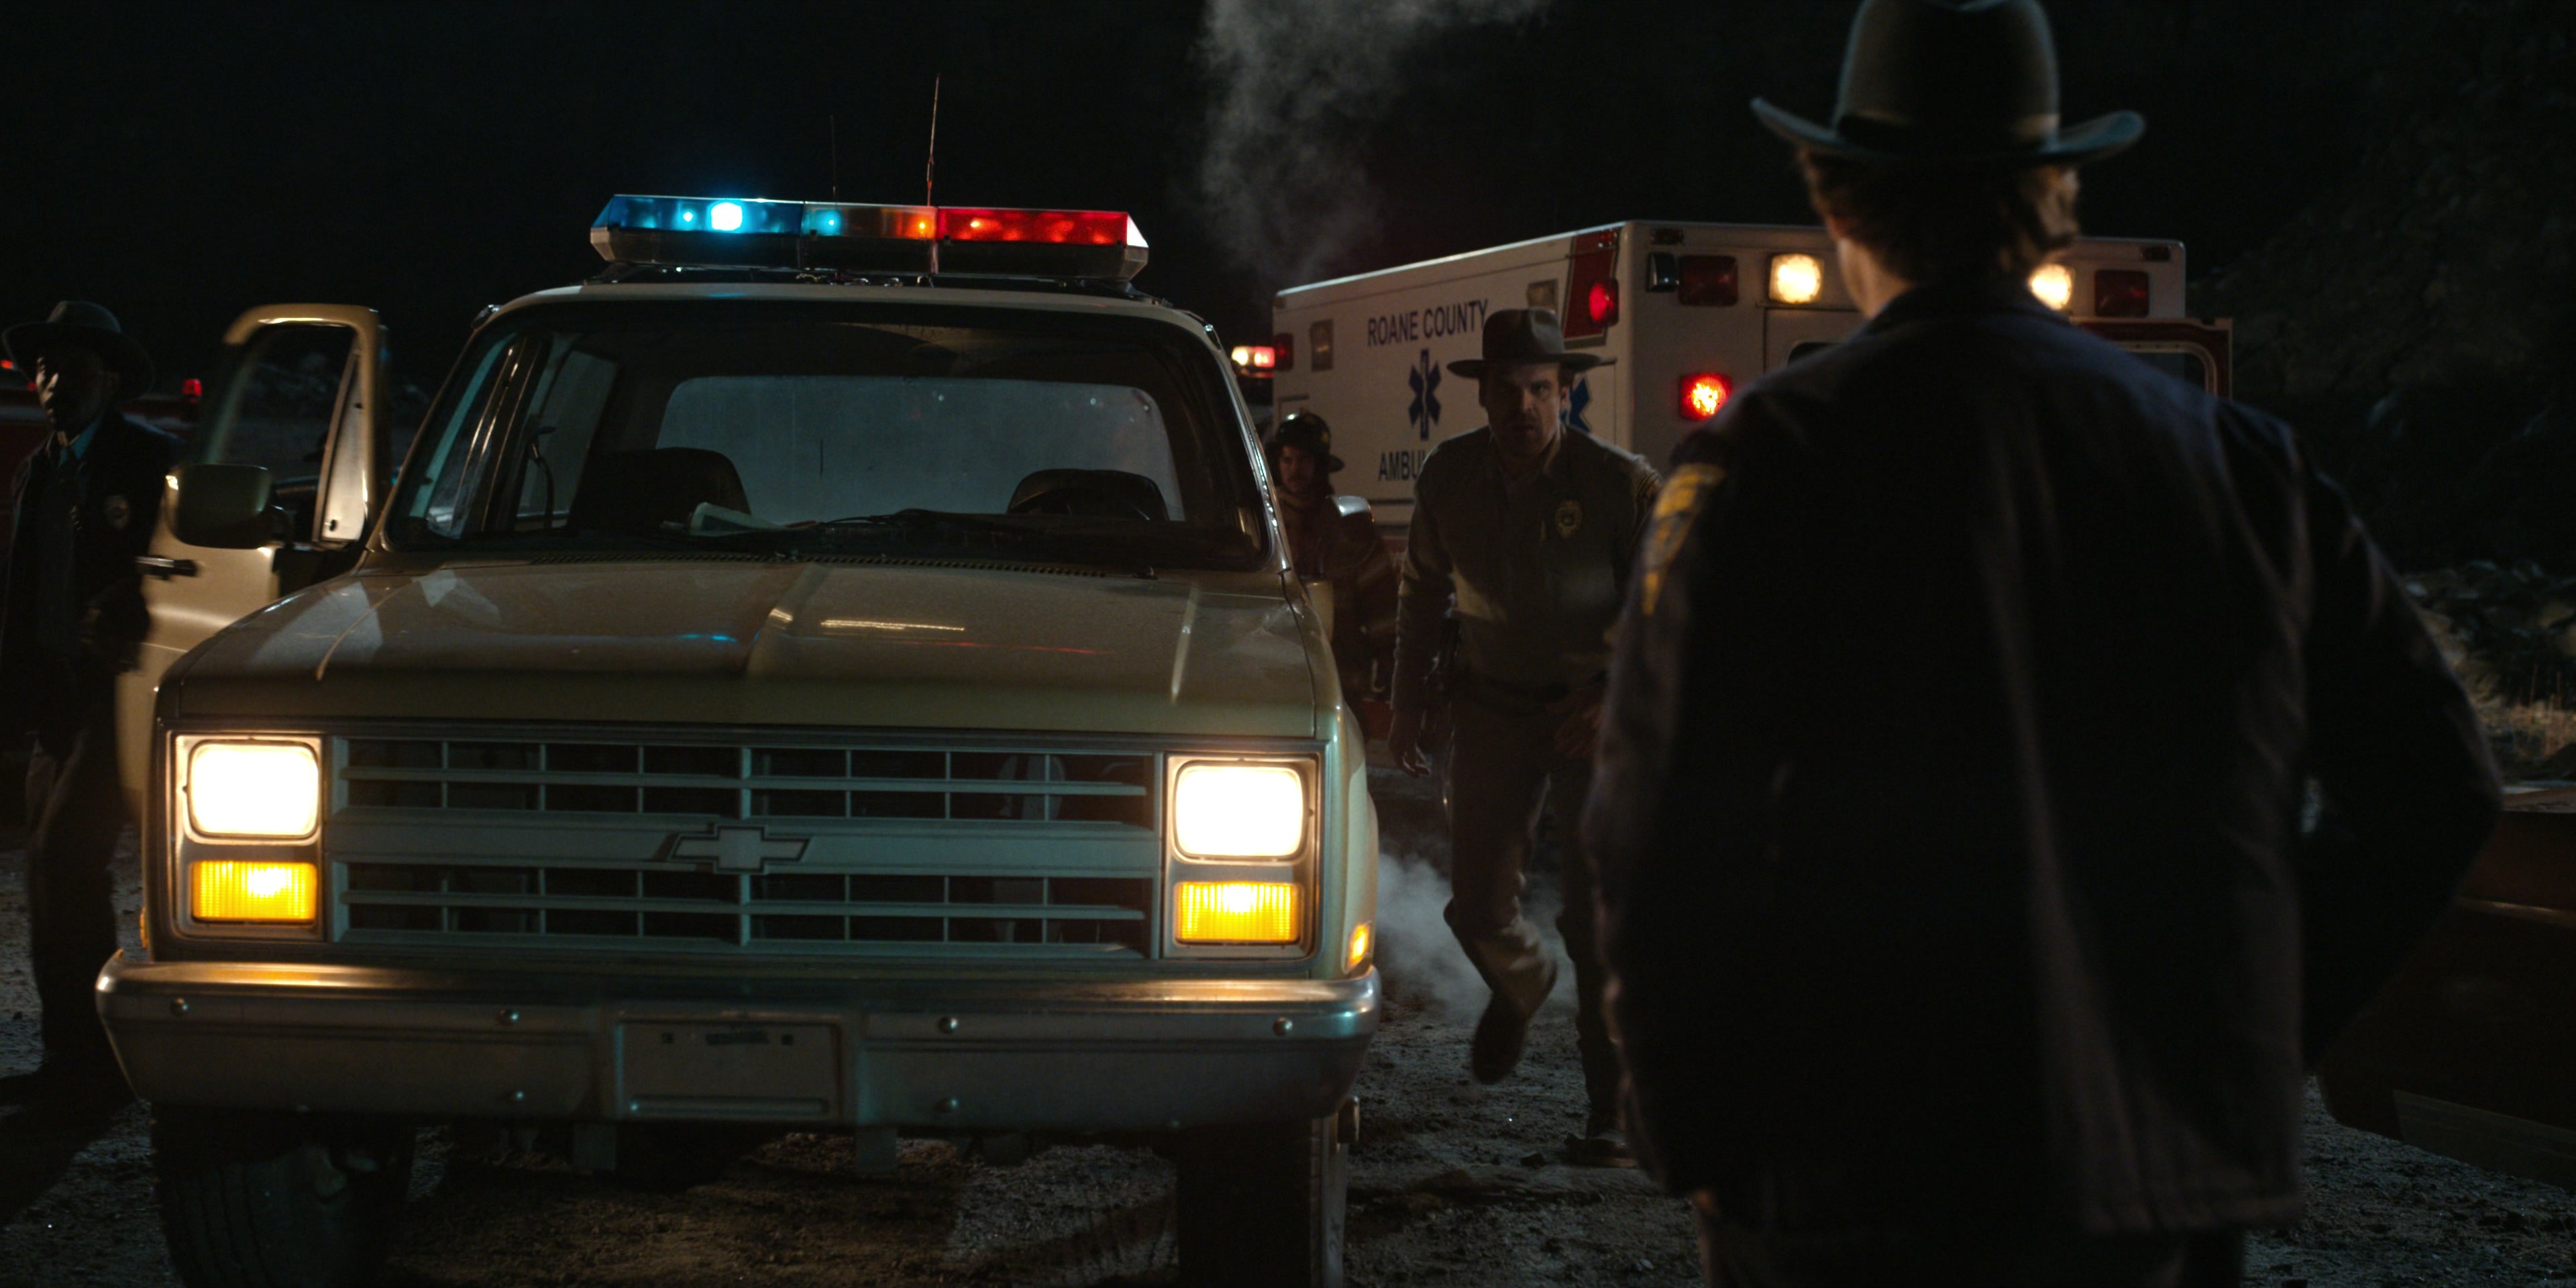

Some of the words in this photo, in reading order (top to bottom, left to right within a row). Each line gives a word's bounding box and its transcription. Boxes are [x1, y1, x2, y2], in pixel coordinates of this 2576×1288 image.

[1367, 311, 1419, 346] ROANE
[1423, 299, 1488, 338] COUNTY
[1377, 449, 1426, 481] AMBU
